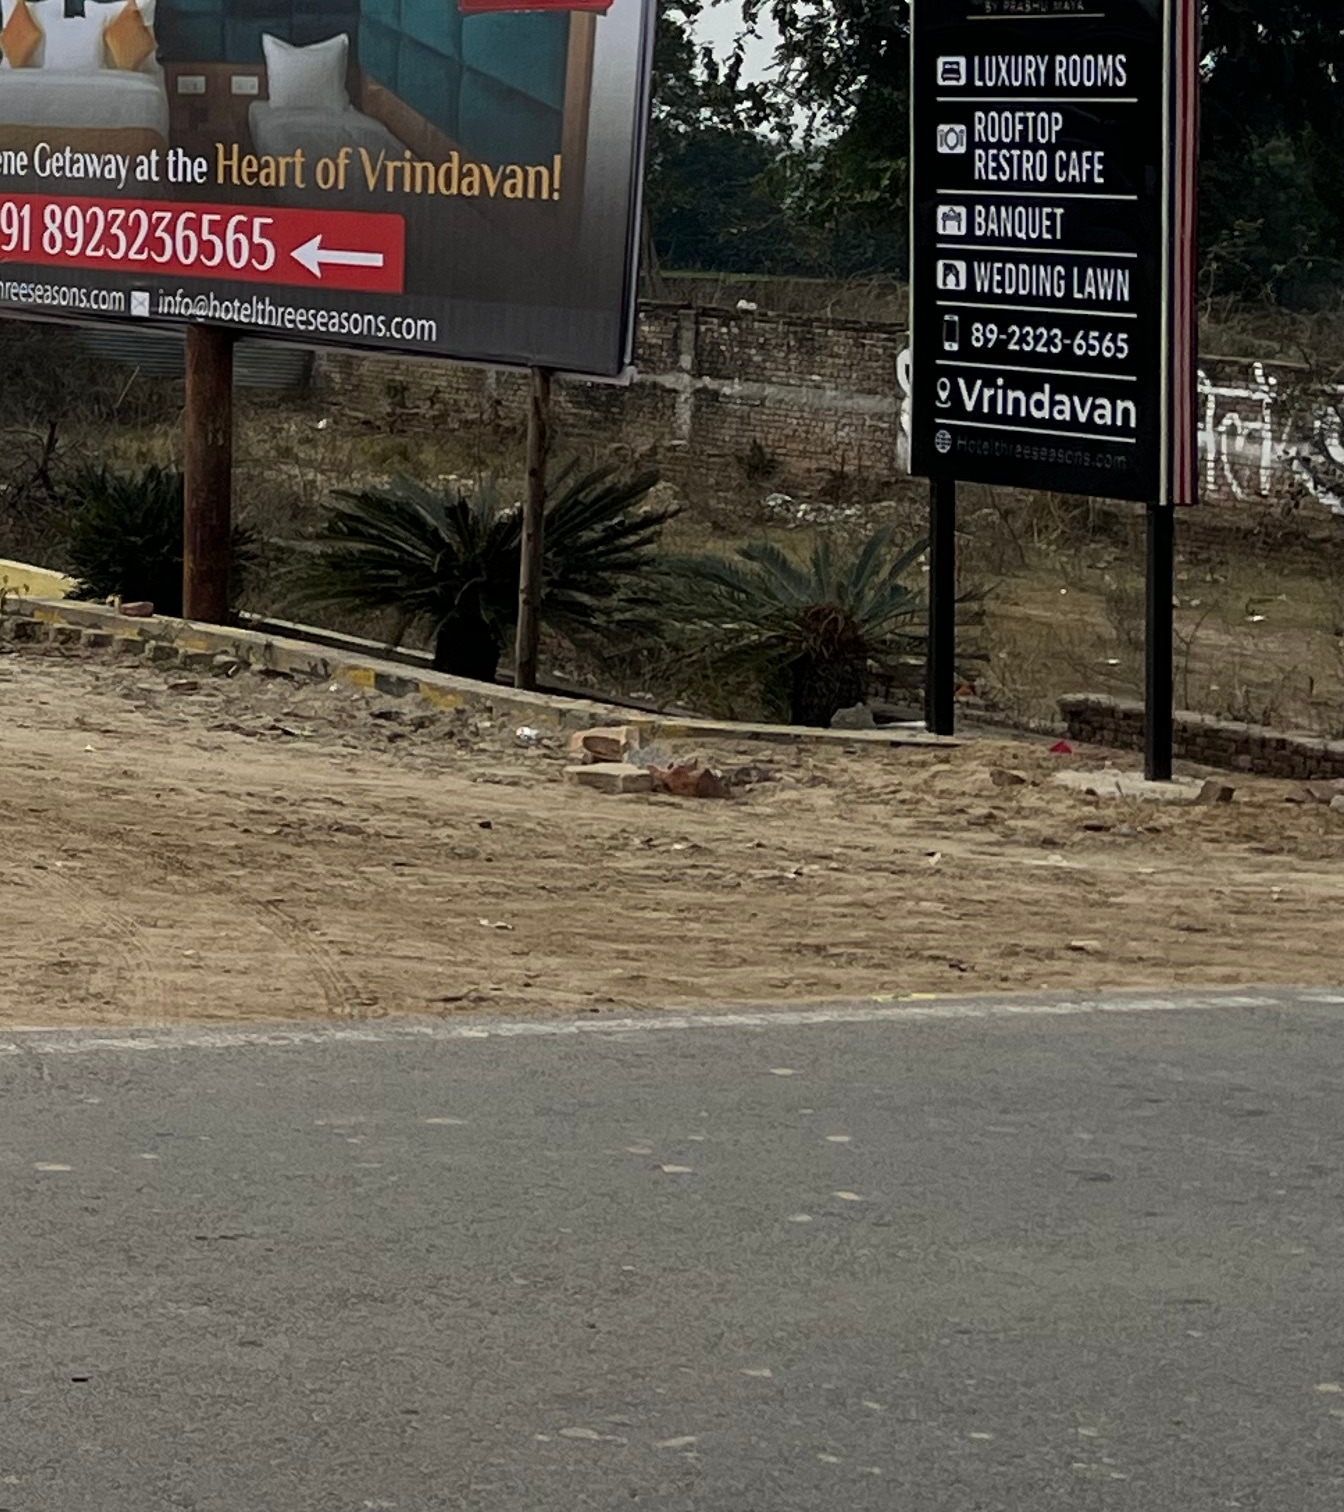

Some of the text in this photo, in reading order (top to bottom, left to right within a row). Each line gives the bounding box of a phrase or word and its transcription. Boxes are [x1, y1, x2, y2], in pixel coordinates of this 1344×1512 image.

[984, 0, 1085, 13] BY PRABHU MAYA
[973, 54, 1127, 87] LUXURY ROOMS
[973, 110, 1063, 144] ROOFTOP
[34, 142, 130, 190] Getaway
[135, 149, 161, 182] at
[166, 148, 208, 184] the
[215, 143, 306, 188] Heart
[314, 146, 353, 190] of
[358, 146, 562, 202] Vrindavan!
[973, 149, 1105, 183] RESTRO CAFE
[42, 203, 276, 271] 8923236565
[973, 205, 1064, 240] BANQUET
[973, 261, 1130, 302] WEDDING LAWN
[157, 289, 438, 342] info@hotelthreeseasons.com
[971, 322, 1129, 359] 89-2323-6565
[957, 377, 1137, 428] Vrindavan
